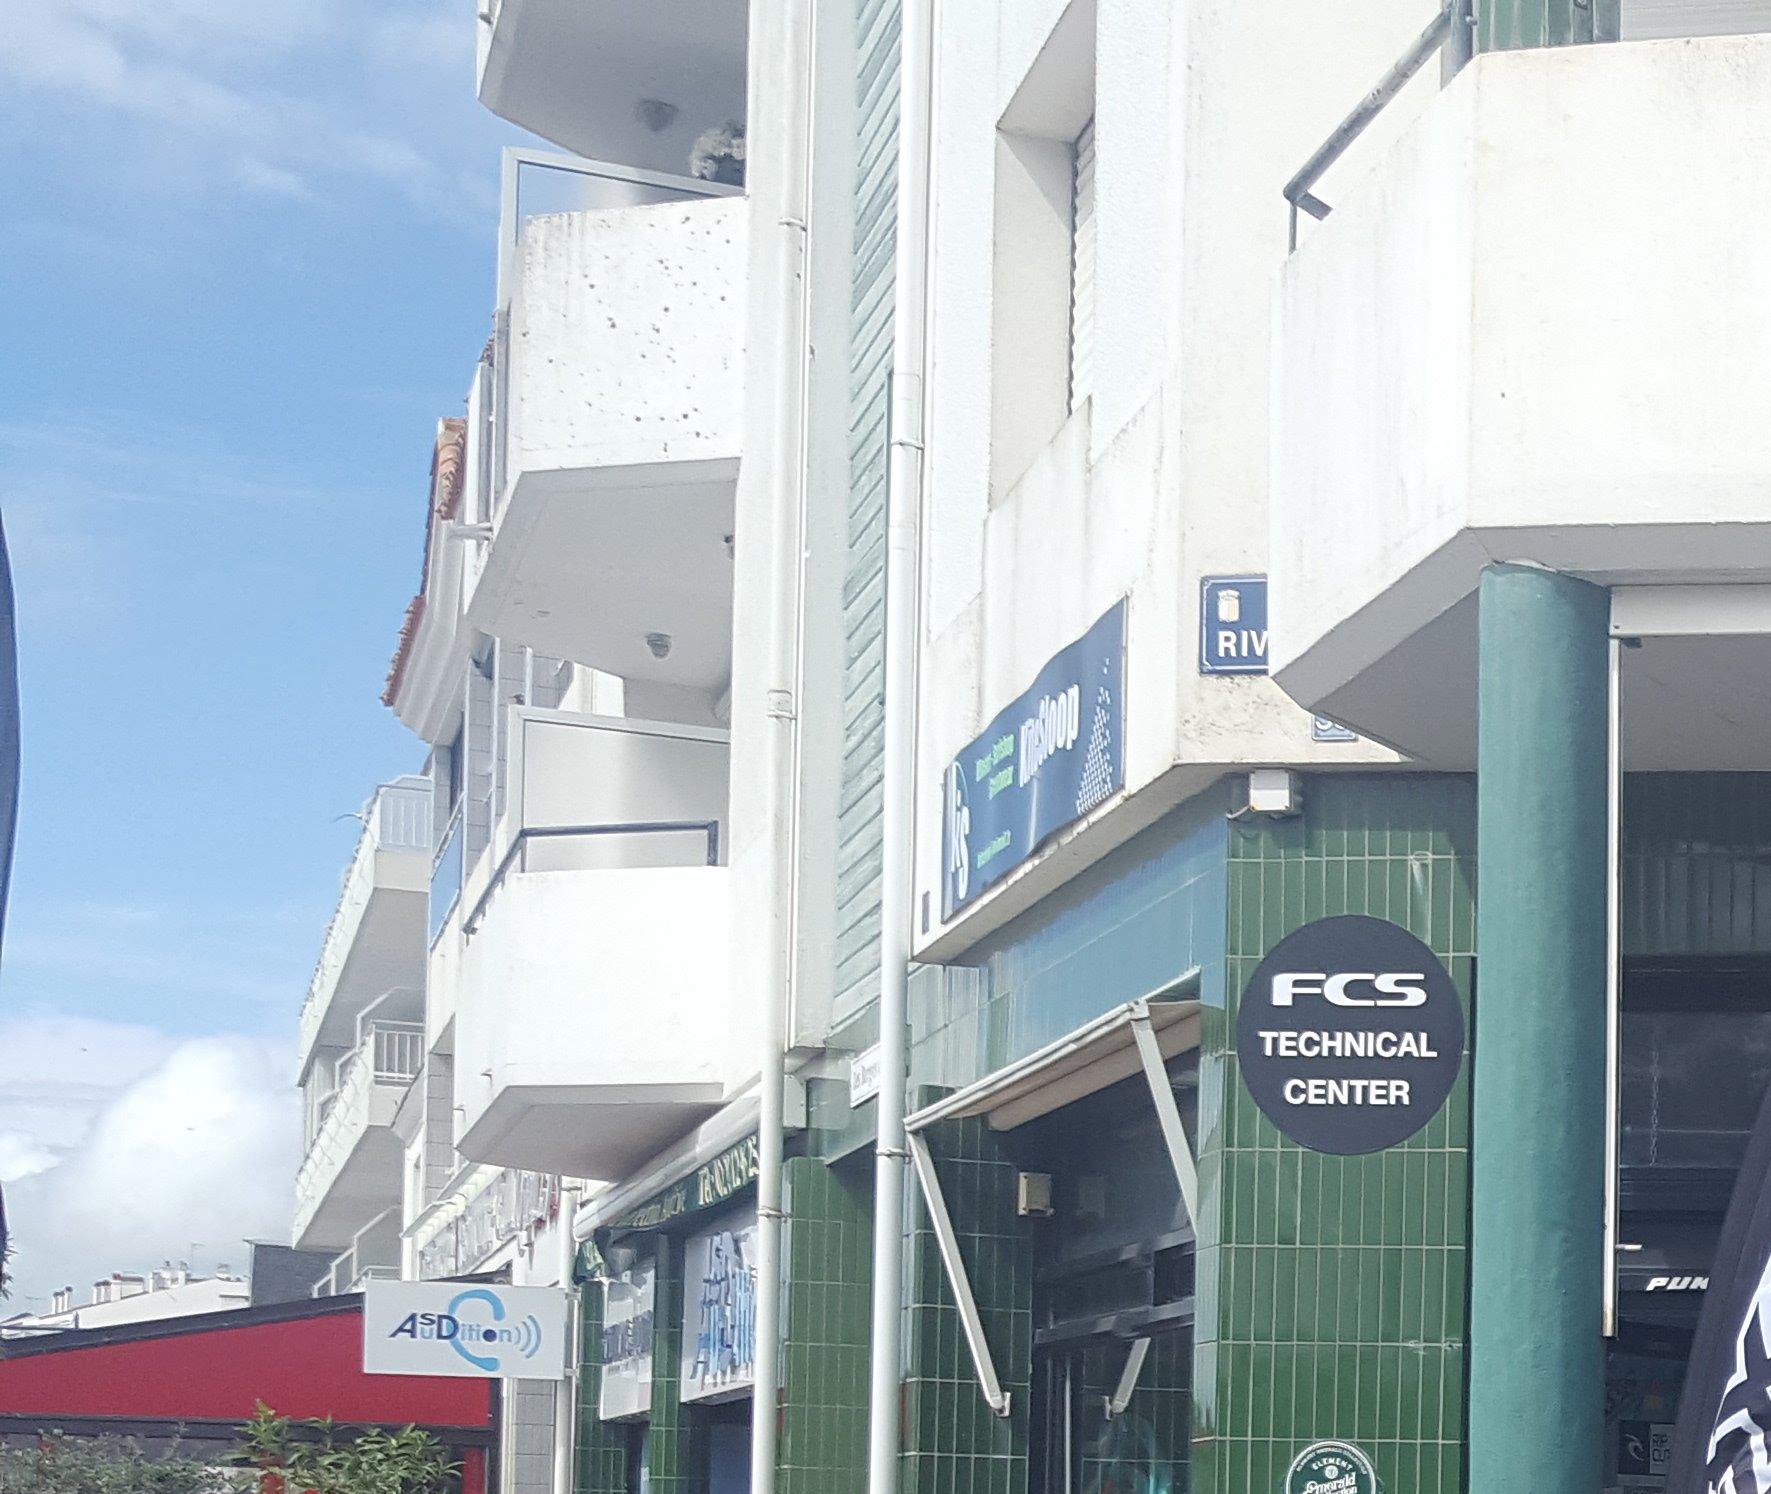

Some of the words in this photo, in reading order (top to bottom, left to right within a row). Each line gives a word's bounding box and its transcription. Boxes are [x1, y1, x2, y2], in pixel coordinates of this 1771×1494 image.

[1272, 973, 1427, 1006] FCS
[1259, 1031, 1437, 1057] TECHNICAL
[1284, 1079, 1410, 1105] CENTER
